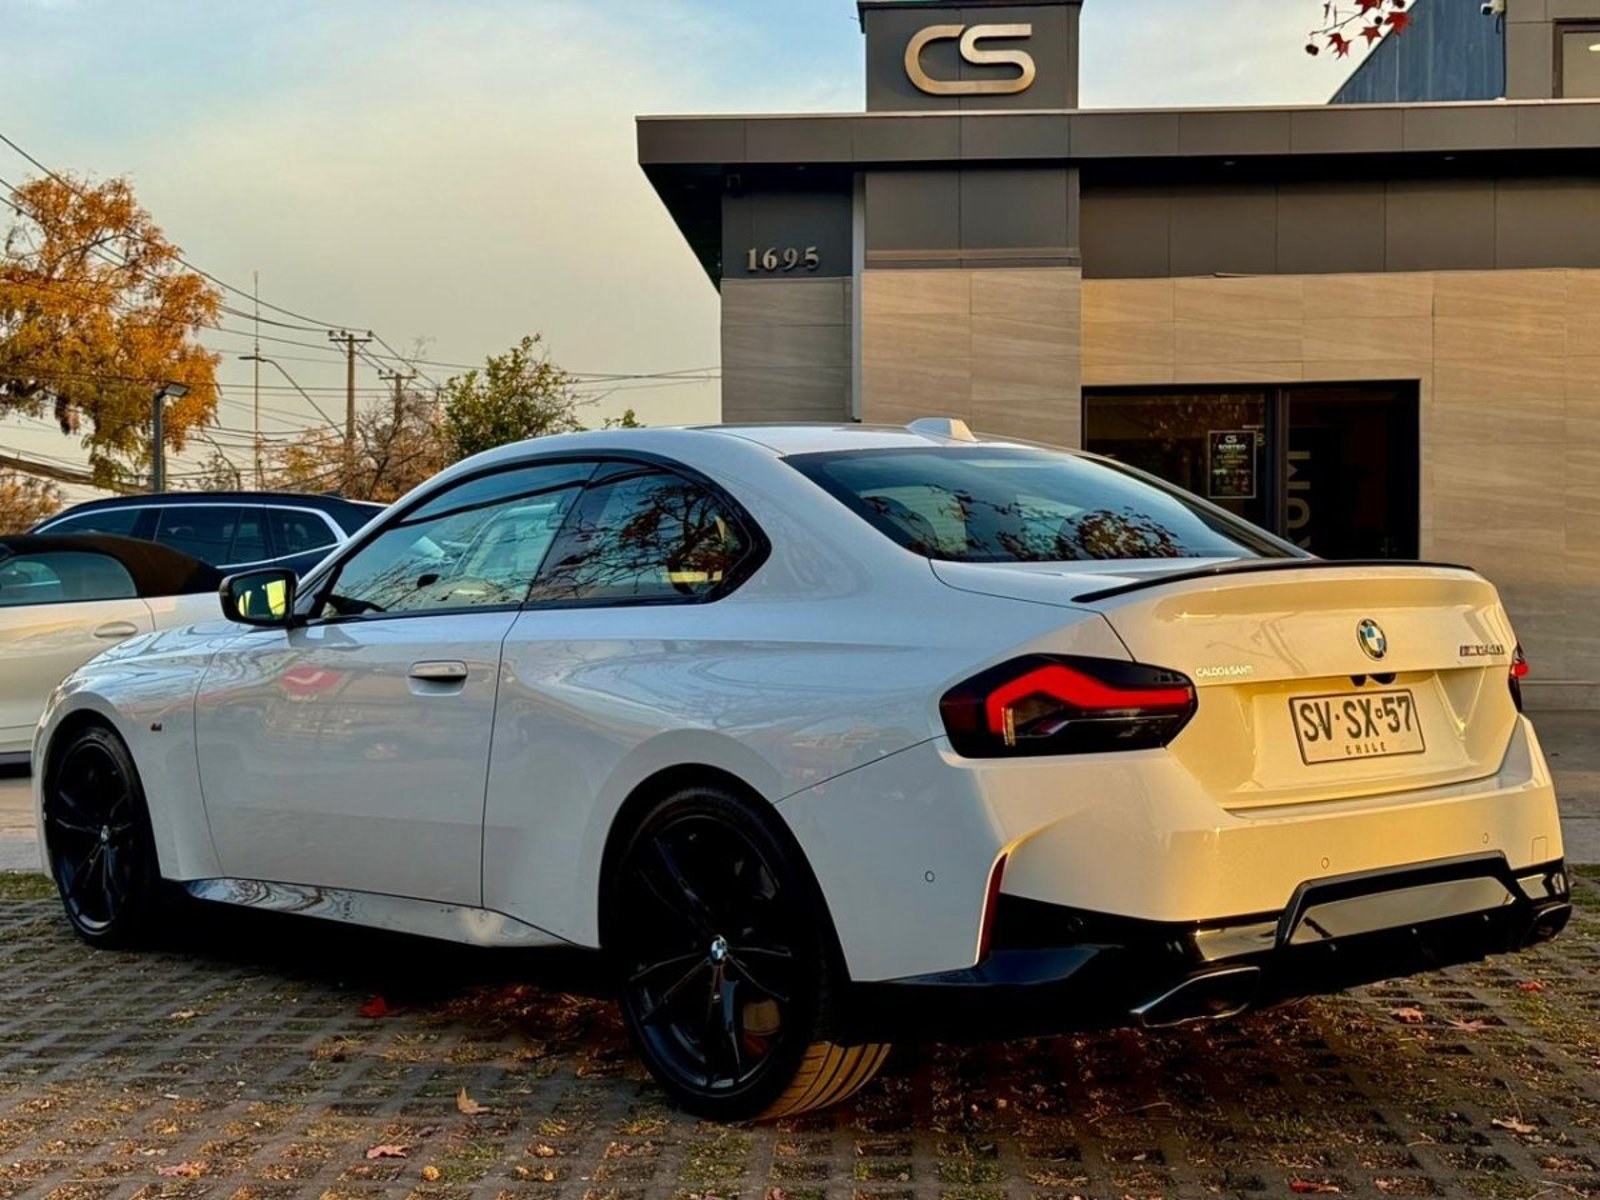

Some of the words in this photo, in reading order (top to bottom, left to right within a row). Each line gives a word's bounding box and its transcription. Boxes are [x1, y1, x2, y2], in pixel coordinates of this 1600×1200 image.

[904, 23, 1036, 95] CS
[746, 246, 819, 271] 1695
[1345, 741, 1387, 755] CHILE
